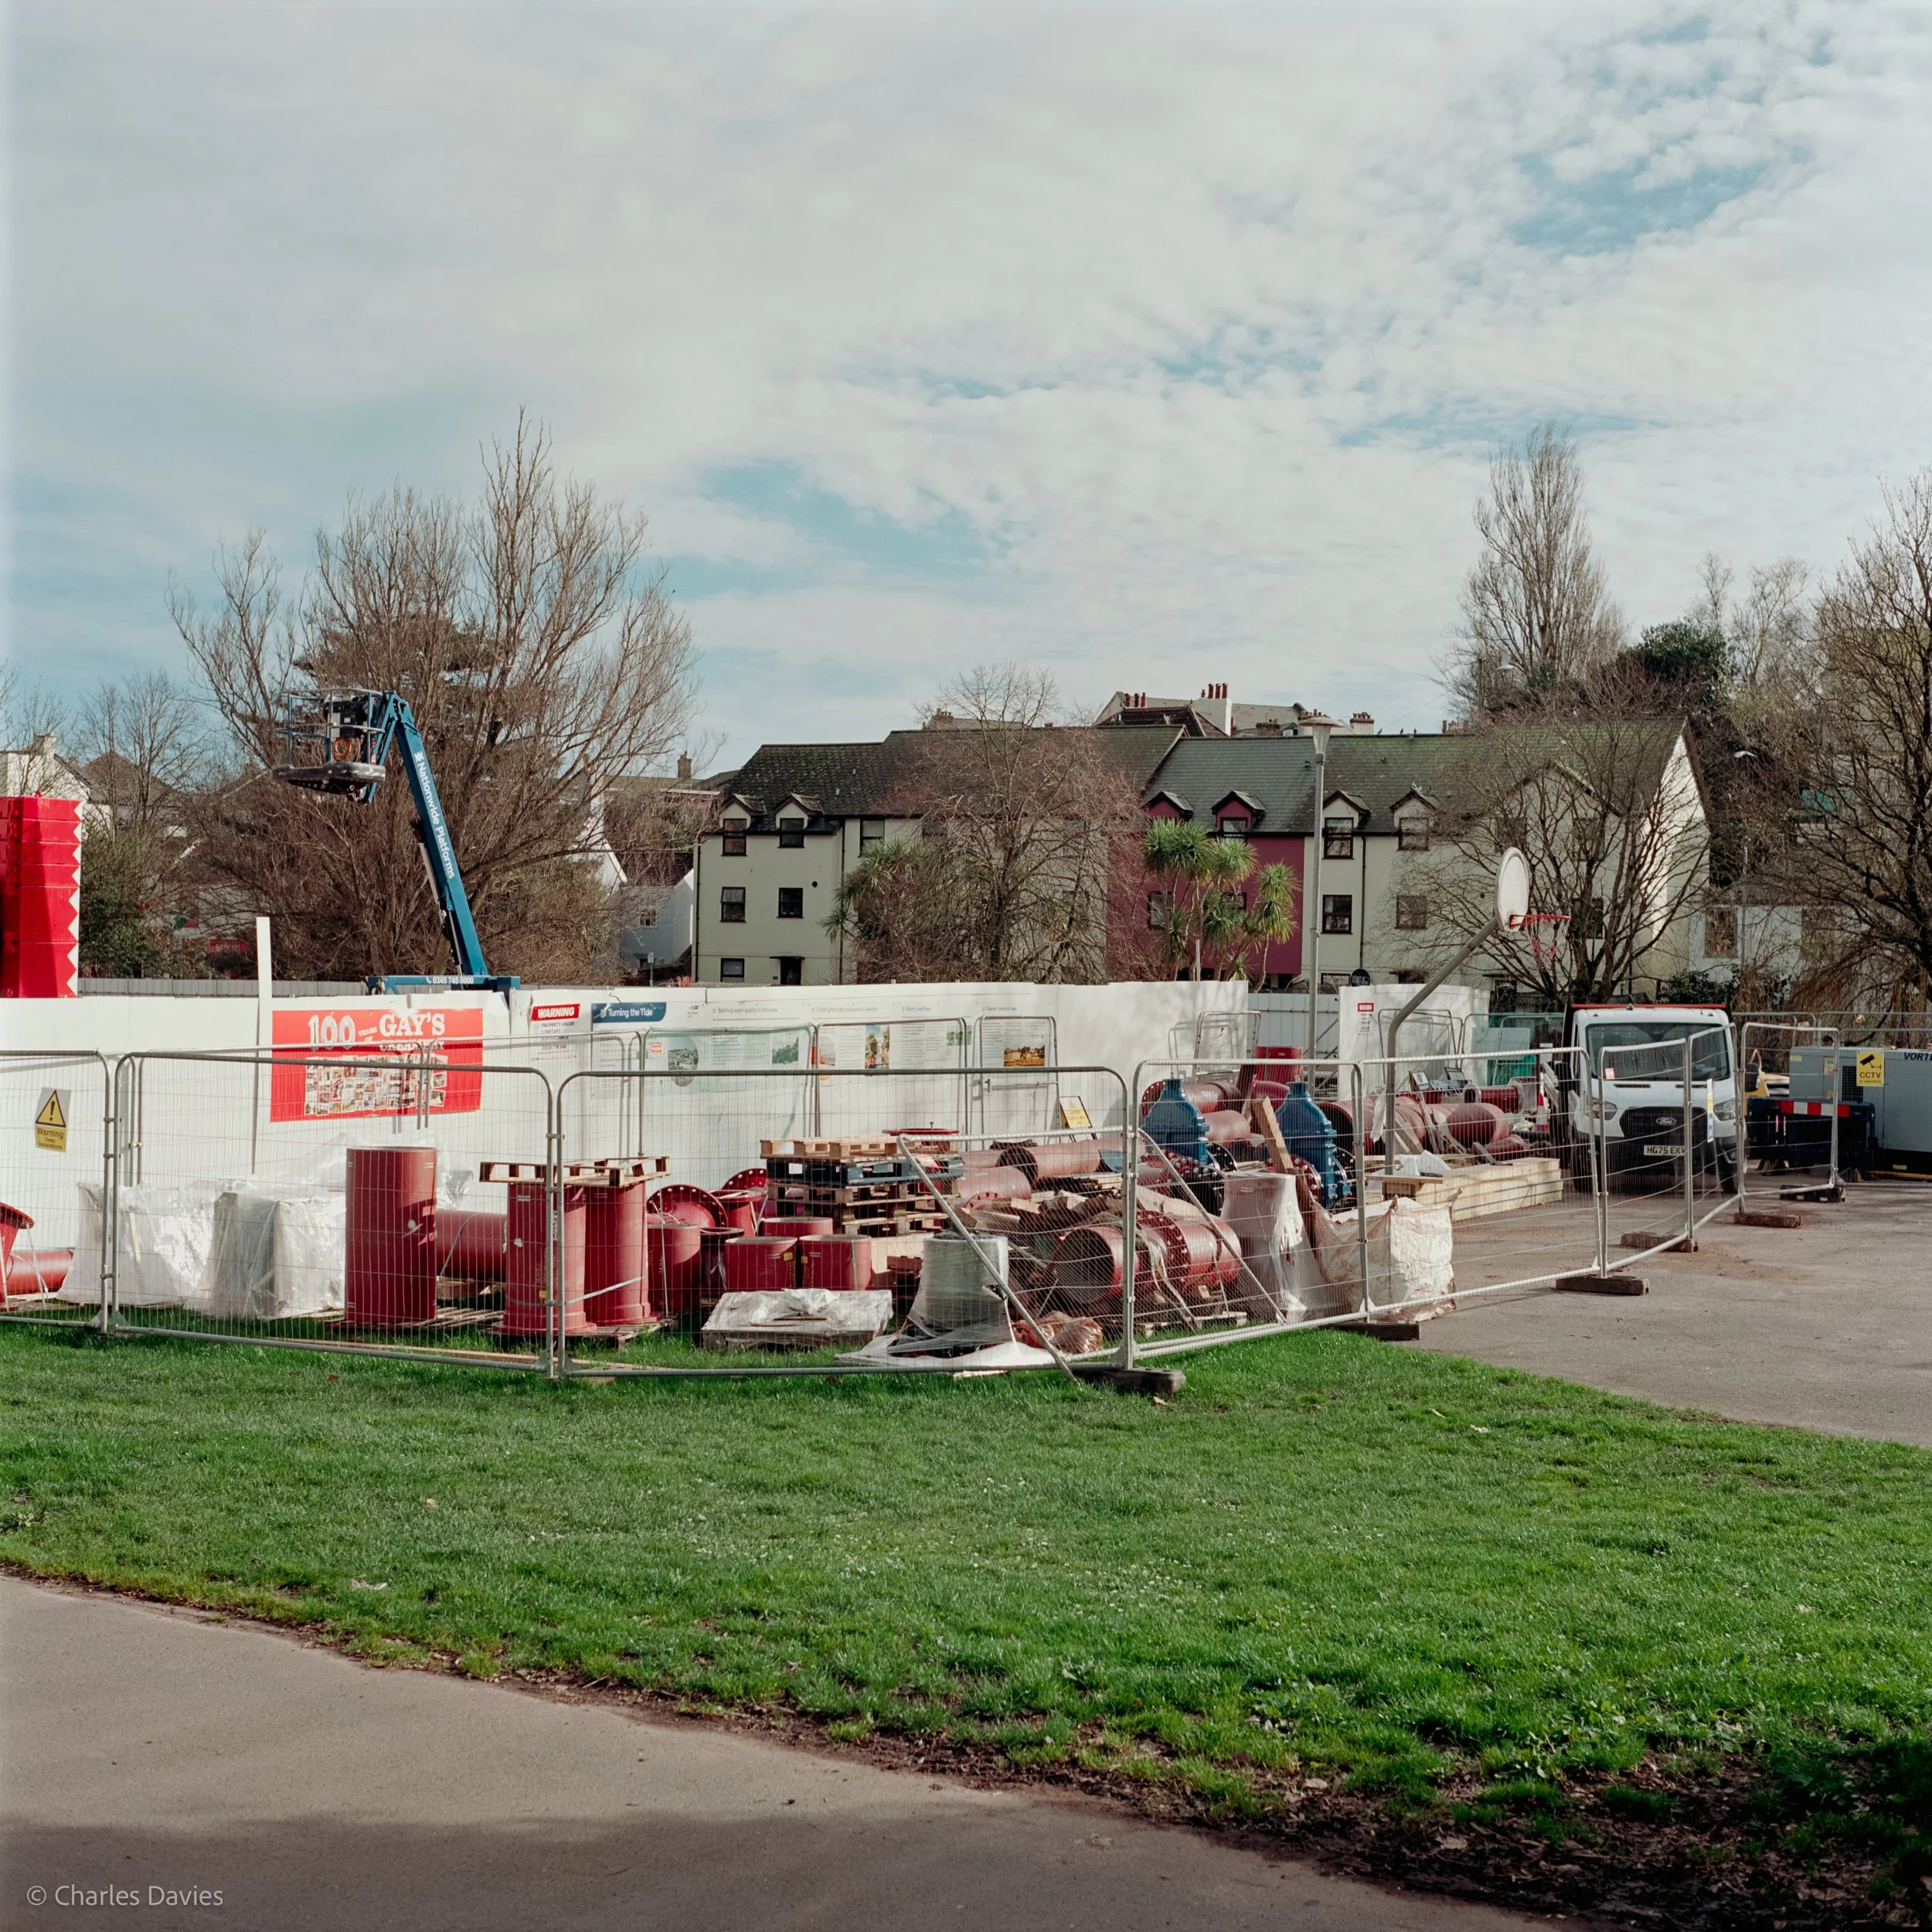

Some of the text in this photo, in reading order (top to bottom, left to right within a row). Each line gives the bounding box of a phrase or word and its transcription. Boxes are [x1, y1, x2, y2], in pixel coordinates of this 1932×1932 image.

[417, 762, 455, 879] Nationwide Platforms
[433, 976, 474, 985] 0345 745 0000
[537, 1006, 575, 1019] WARNING
[608, 1007, 653, 1019] Turning the Tide
[379, 1012, 446, 1037] GAY'S
[308, 1013, 356, 1052] 100
[357, 1026, 378, 1037] YEARS
[36, 1127, 64, 1140] Warning
[1647, 1146, 1668, 1155] HG75
